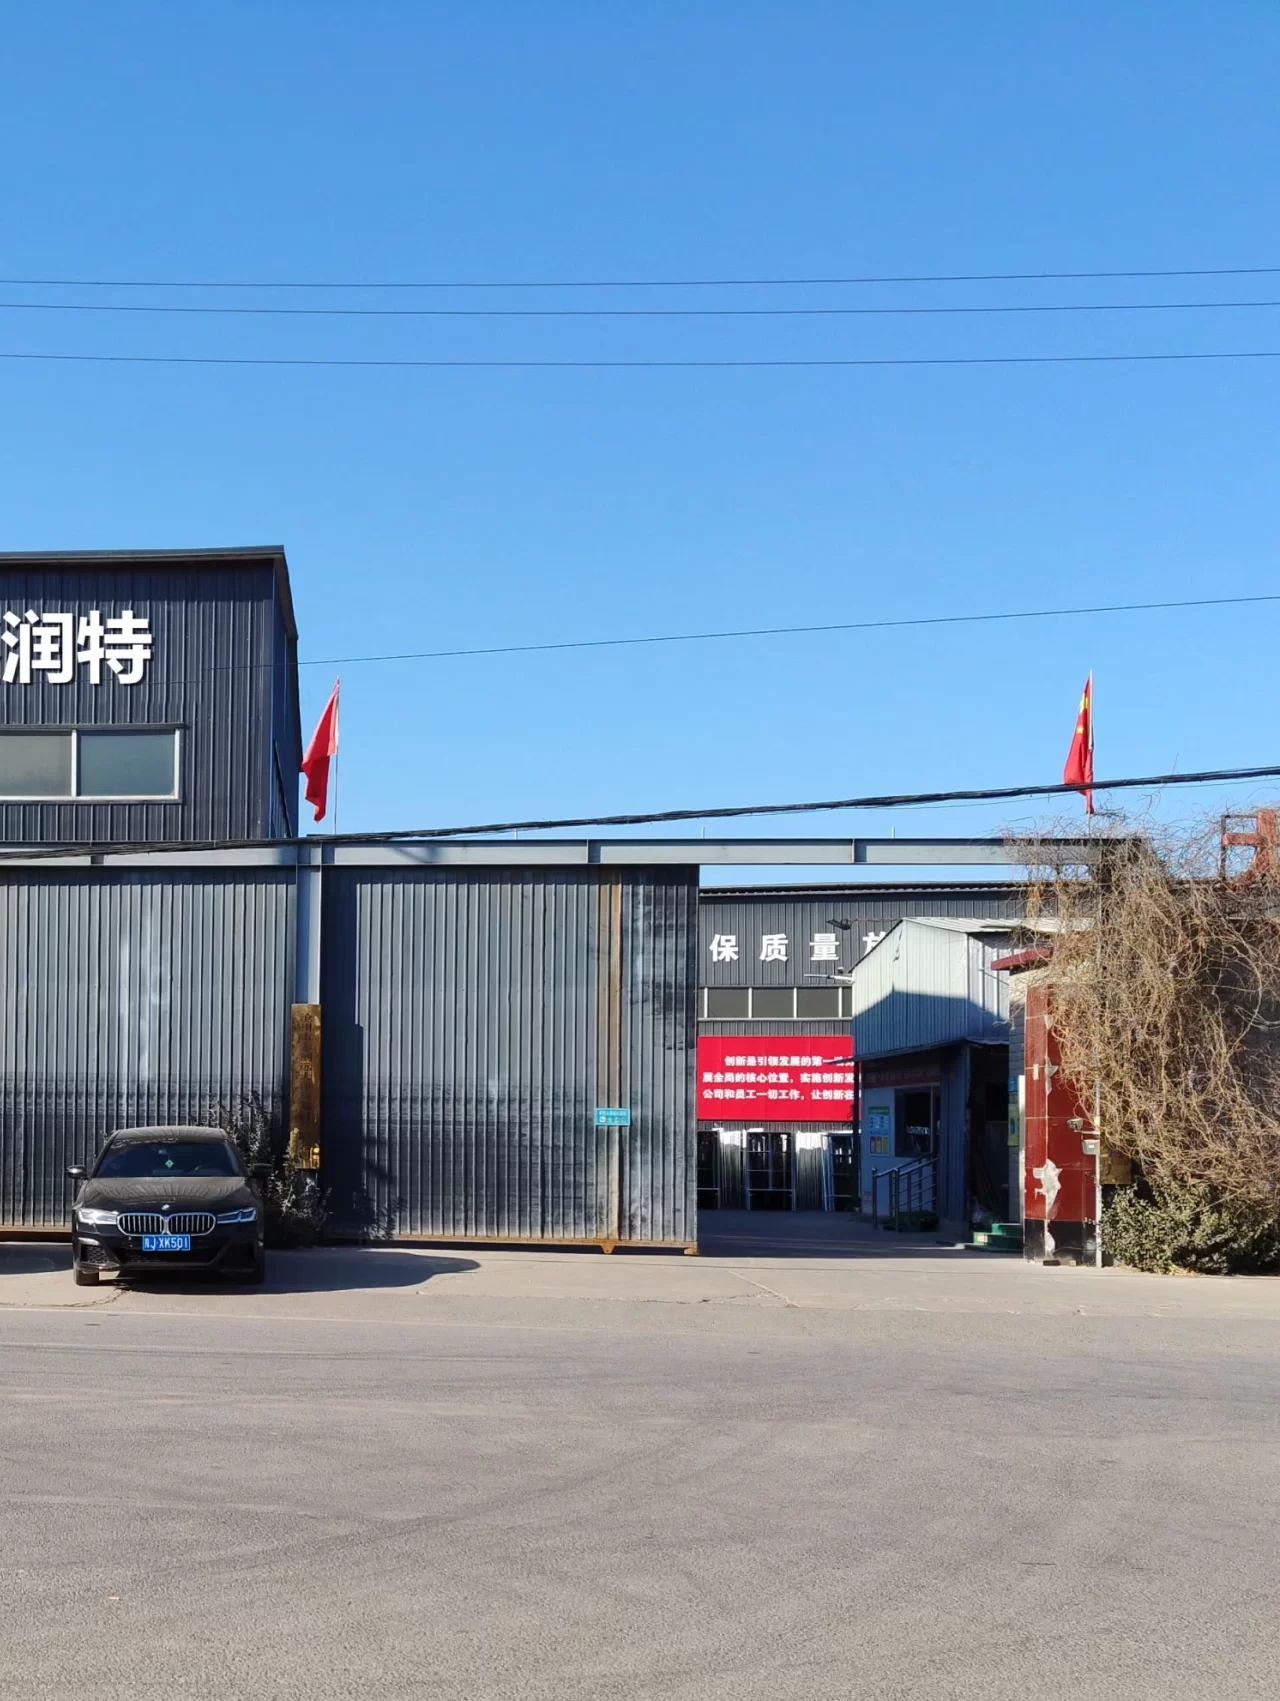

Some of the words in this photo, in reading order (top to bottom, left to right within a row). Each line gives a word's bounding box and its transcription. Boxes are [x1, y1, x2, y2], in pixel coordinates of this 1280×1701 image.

[702, 1072, 862, 1084] 展全局的核心位置，实施创新发
[702, 1088, 862, 1100] 公司和员工一切工作，让创新在
